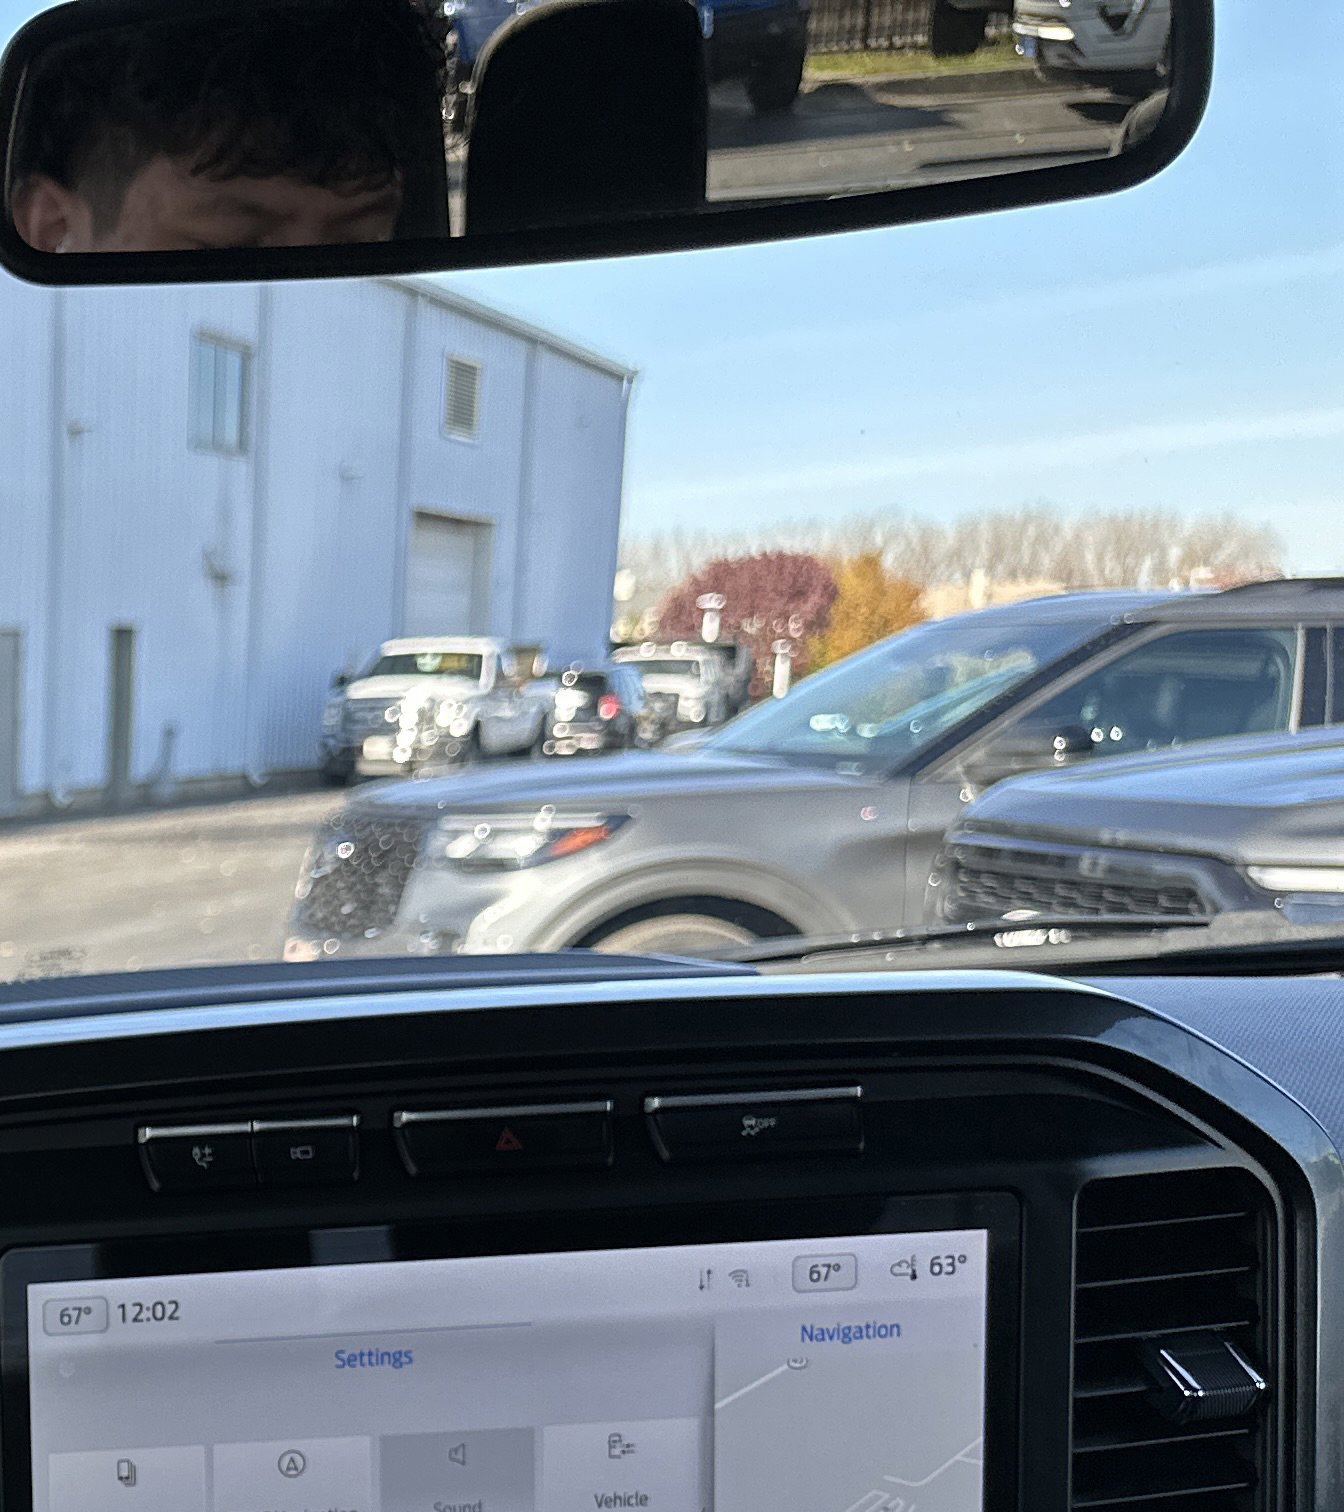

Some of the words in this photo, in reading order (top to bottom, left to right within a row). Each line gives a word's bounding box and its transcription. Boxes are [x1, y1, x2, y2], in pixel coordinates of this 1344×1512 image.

[808, 1262, 842, 1284] 67°
[928, 1253, 968, 1278] 63°
[58, 1304, 93, 1327] 67°
[116, 1299, 181, 1325] 12:02
[800, 1320, 902, 1346] Navigation
[334, 1345, 414, 1372] Settings
[593, 1489, 649, 1510] Vehicle
